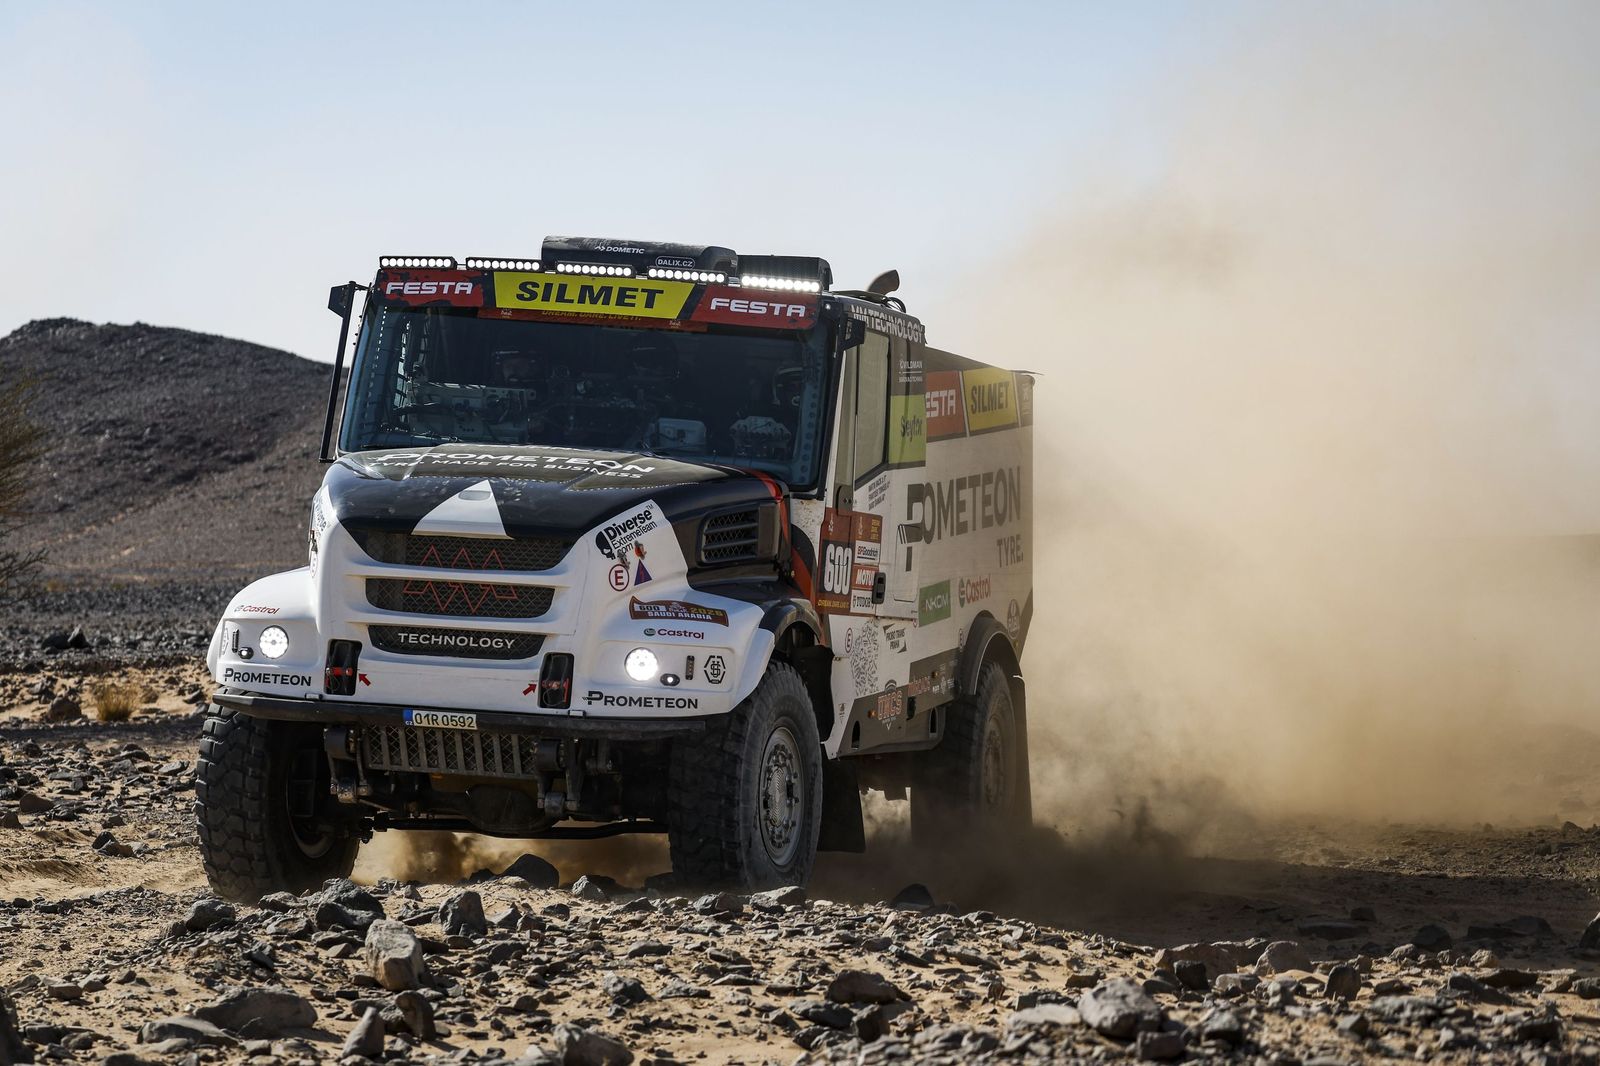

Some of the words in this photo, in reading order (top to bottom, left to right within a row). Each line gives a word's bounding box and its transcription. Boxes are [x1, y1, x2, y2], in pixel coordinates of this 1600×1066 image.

[605, 245, 646, 254] DOMETIC
[657, 258, 694, 268] DALIX.CZ
[385, 281, 474, 295] FESTA
[515, 280, 665, 310] SILMET
[709, 297, 807, 318] FESTA
[926, 389, 957, 418] ESTA
[970, 382, 1010, 415] SILMET
[374, 453, 656, 473] PROMETEON
[543, 464, 644, 479] BUSINESS
[603, 509, 653, 540] Diverse
[611, 521, 658, 550] ExtremeTeam
[614, 569, 625, 586] E
[823, 543, 853, 596] 600
[966, 573, 992, 604] Castrol
[242, 605, 281, 615] Castrol
[677, 613, 713, 621] ARABIA
[398, 633, 515, 649] TECHNOLOGY
[657, 628, 705, 640] Castrol
[224, 667, 312, 687] PROMETEON
[587, 690, 699, 709] PROMETEON
[414, 712, 439, 726] 01R
[441, 714, 476, 729] 0592
